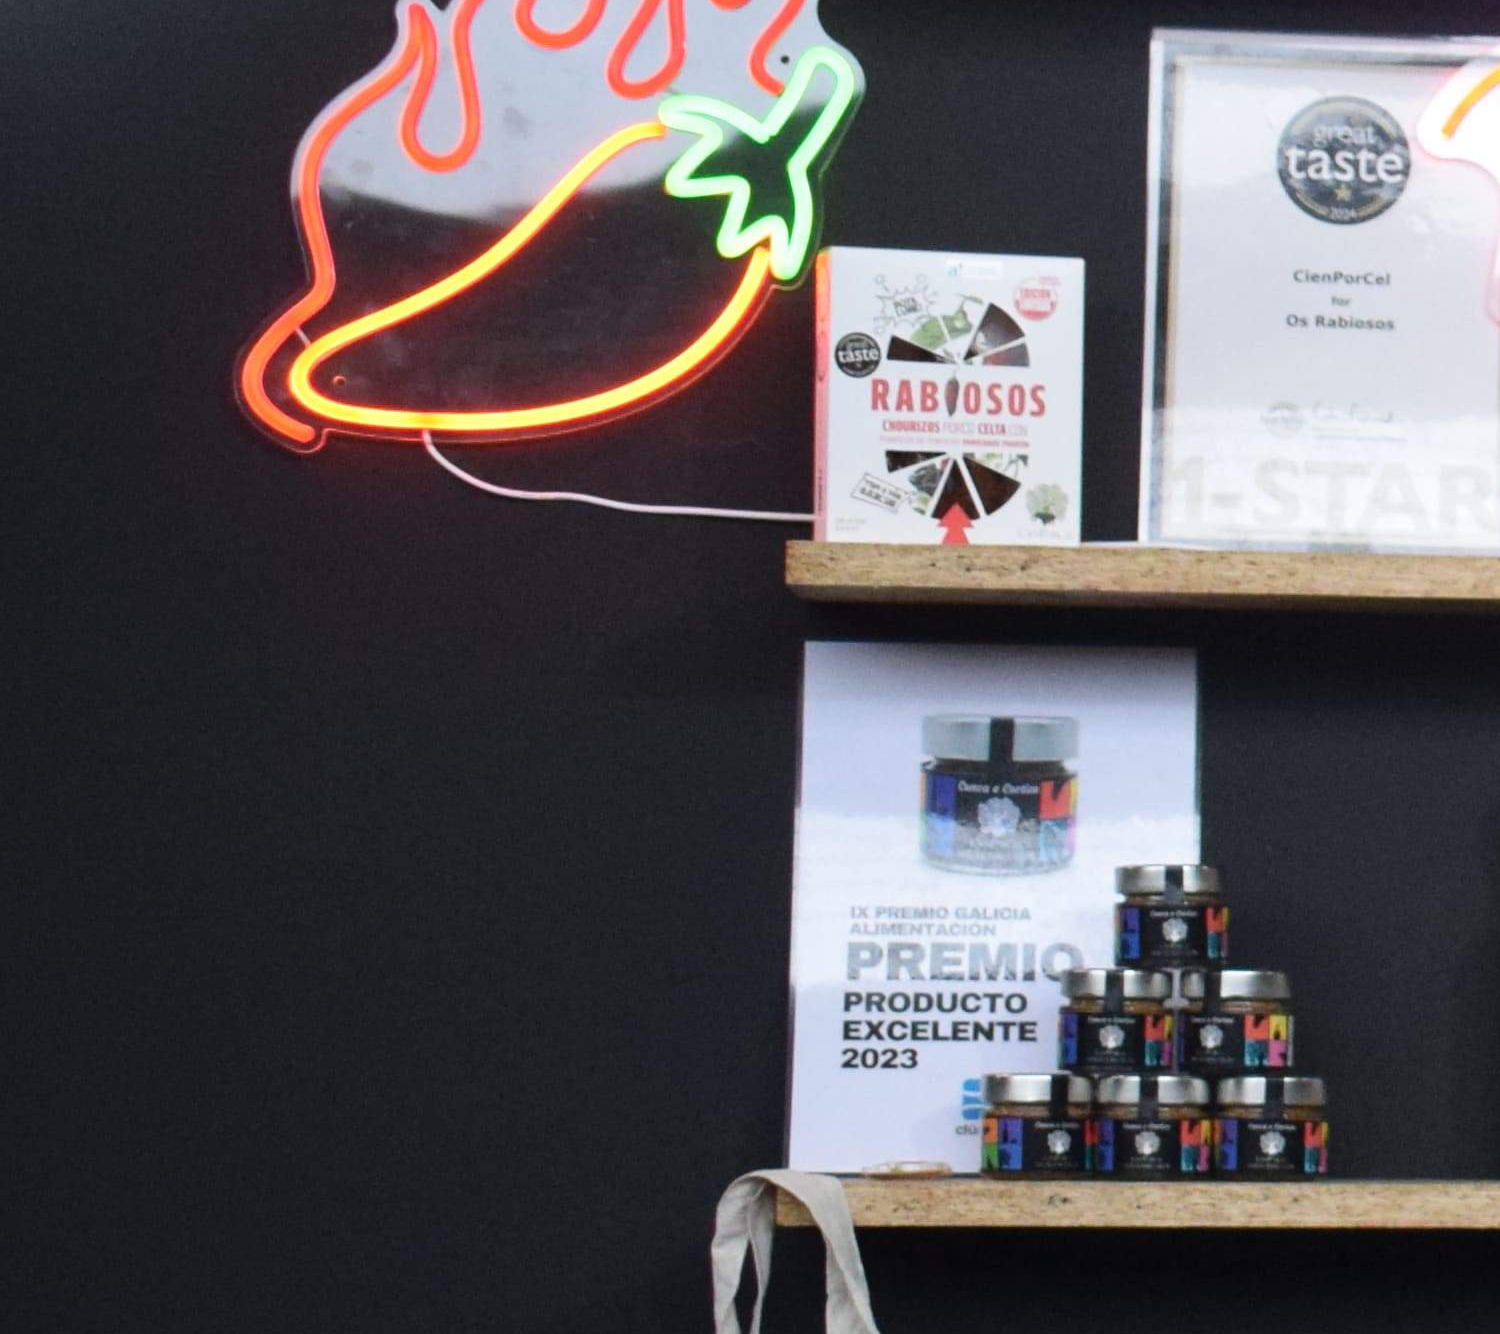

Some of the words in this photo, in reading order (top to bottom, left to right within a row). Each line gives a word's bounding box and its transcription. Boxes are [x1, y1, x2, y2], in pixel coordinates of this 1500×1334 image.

[1314, 124, 1376, 146] great
[1285, 146, 1405, 184] taste
[1293, 268, 1391, 286] CienPorCel
[1332, 295, 1351, 307] for
[1285, 313, 1309, 329] Os
[1314, 315, 1397, 332] Rabiosos
[870, 376, 1046, 418] RABIOSOS
[977, 421, 1007, 435] CELTA
[850, 906, 869, 919] IX
[874, 906, 950, 920] PREMIO
[954, 907, 1032, 921] GALICIA
[849, 921, 997, 937] ALIMENTACIÓN
[846, 941, 1085, 983] PREMIO
[843, 991, 1028, 1014] PRODUCTO
[842, 1019, 1038, 1042] EXCELENTE
[841, 1047, 918, 1069] 2023
